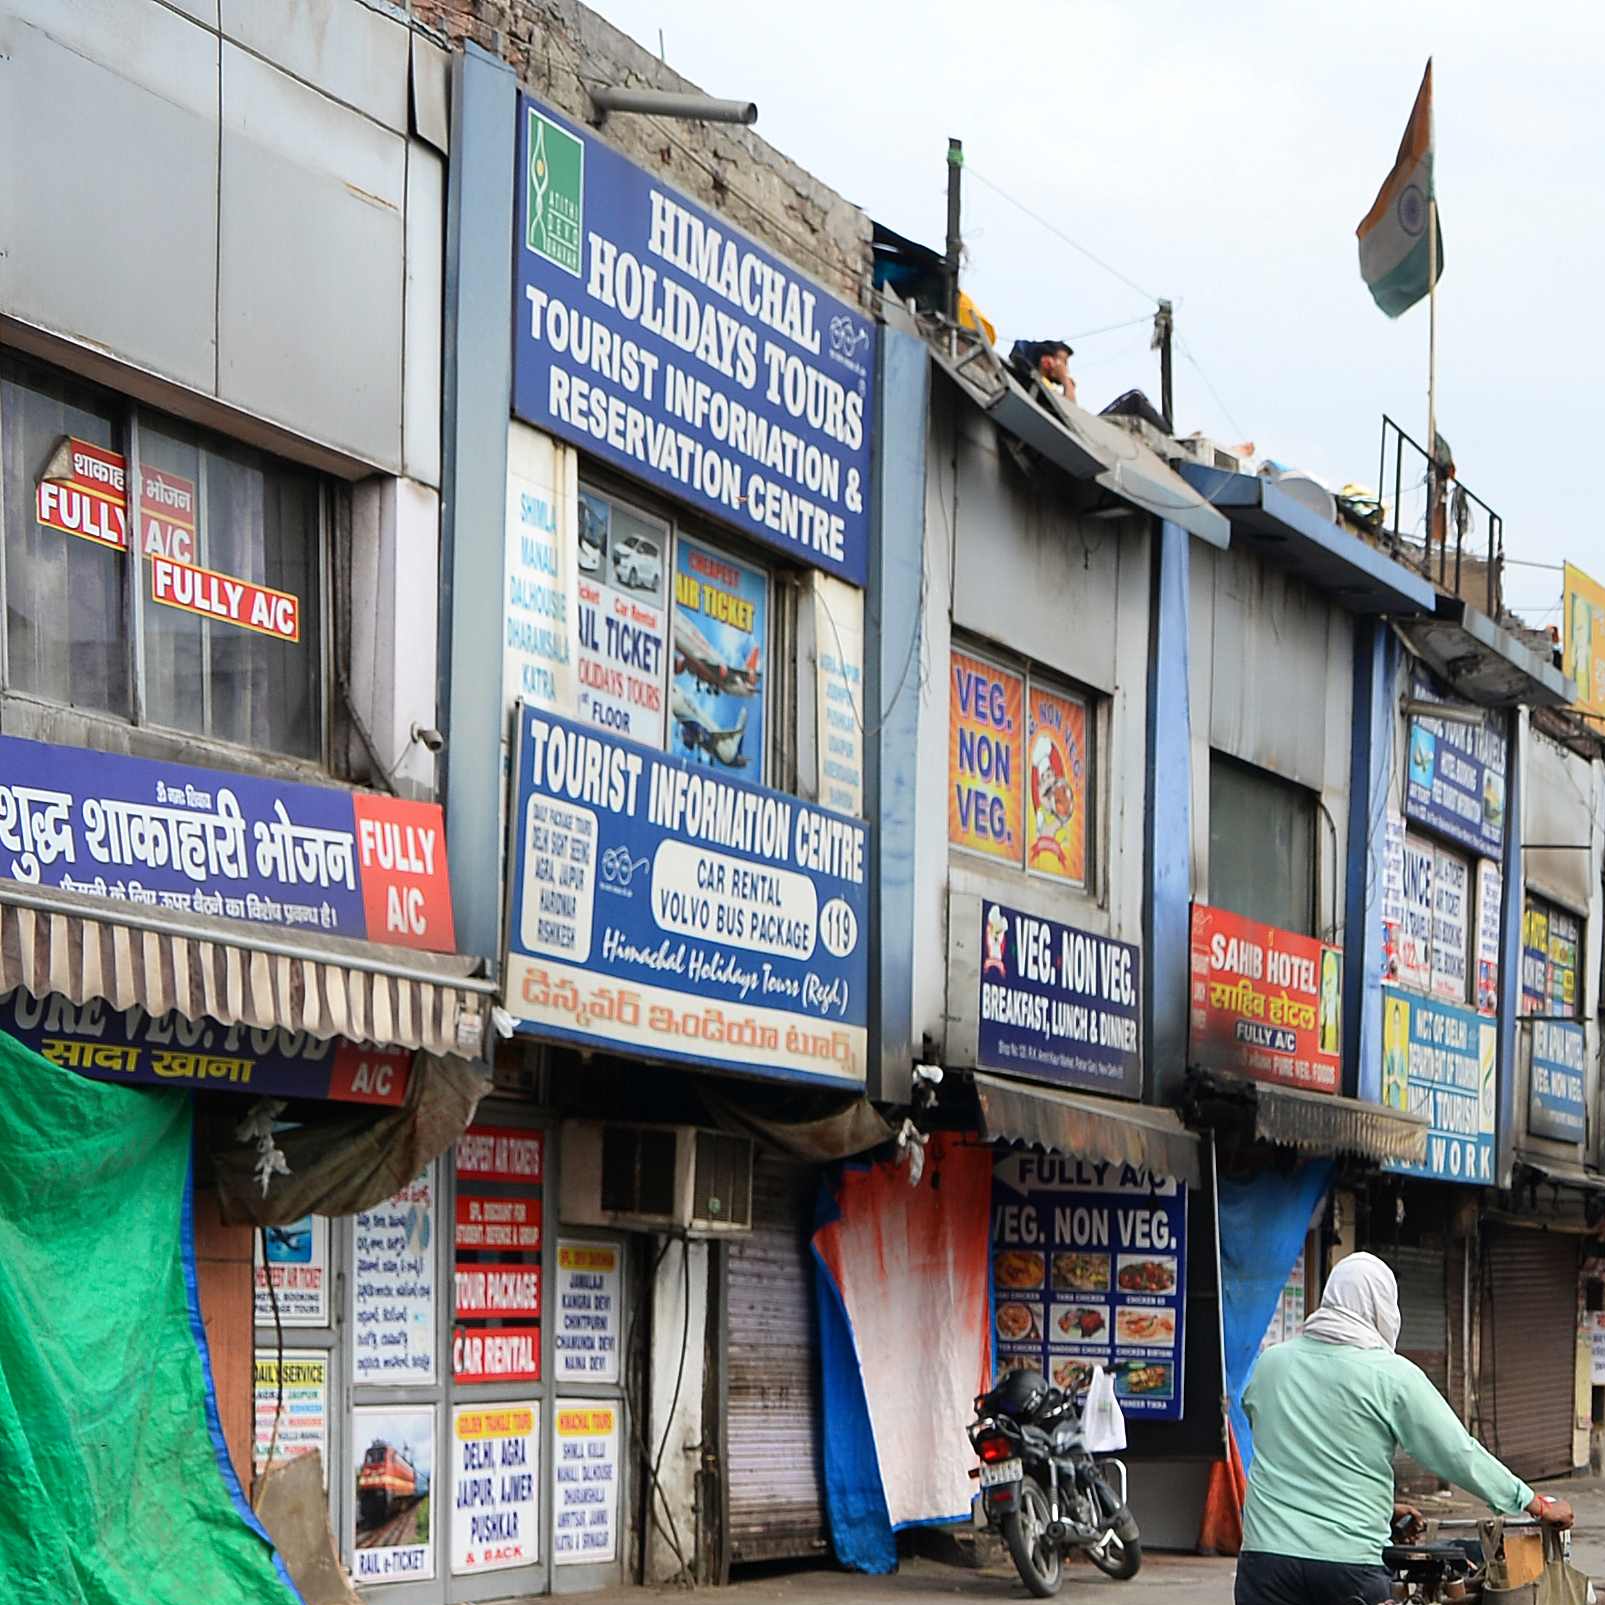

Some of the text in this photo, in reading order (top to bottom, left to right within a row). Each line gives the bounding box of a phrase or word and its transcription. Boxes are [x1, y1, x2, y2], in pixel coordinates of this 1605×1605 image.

[647, 189, 821, 356] HIMACHAL
[586, 232, 864, 451] HOLIDAYS TOURS
[525, 284, 659, 401] TOURIST
[665, 364, 840, 503] INFORMATION
[845, 466, 863, 514] &
[548, 363, 741, 512] RESERVATION
[745, 473, 846, 563] CENTRE
[146, 476, 192, 512] भोजन
[145, 519, 192, 563] A/C
[155, 560, 295, 635] FULLY A/C
[675, 572, 755, 633] AIR TICKET
[605, 616, 663, 676] TICKET
[578, 657, 624, 698] OLIDAYS
[627, 675, 662, 712] TOURS
[956, 668, 1012, 730] VEG.
[592, 700, 631, 734] FLOOR
[959, 727, 1010, 784] NON
[531, 720, 864, 884] TOURIST INFORMATION CENTRE
[956, 783, 1012, 843] VEG.
[0, 784, 355, 891] शुद्ध शाकाहारी भोजन
[360, 818, 436, 875] FULLY
[160, 889, 191, 914] ऊपर
[226, 895, 246, 918] का
[698, 859, 782, 908] CAR RENTAL
[386, 886, 427, 936] A/C
[660, 888, 710, 930] VOLVO
[717, 903, 744, 937] BUS
[750, 910, 809, 951] PACKAGE
[828, 904, 851, 950] 119
[603, 927, 685, 974] Himachal
[689, 955, 759, 998] Holidays
[762, 963, 800, 998] Tours
[1016, 916, 1055, 985] VEG.
[1062, 931, 1097, 996] NON
[1100, 942, 1136, 1007] VEG.
[1211, 933, 1317, 994] SAHIB HOTEL
[13, 987, 105, 1037] URE
[123, 1003, 213, 1047] VEG.
[982, 983, 1136, 1053] BREAKFAST, LUNCH & DINNER
[1269, 990, 1316, 1030] होटल
[41, 1039, 256, 1084] सादा खाना
[1237, 1023, 1296, 1051] FULLY A/C
[351, 1064, 394, 1095] A/C
[1018, 1157, 1109, 1186] FULLY
[1055, 1207, 1109, 1246] NON
[1117, 1208, 1177, 1249] VEG.
[455, 1271, 538, 1310] TOUR PACKAGE
[284, 1364, 323, 1383] SERVICE
[453, 1336, 535, 1374] CAR RENTAL
[501, 1438, 527, 1468] AGRA
[501, 1474, 533, 1504] AJMER
[471, 1512, 519, 1545] PUSHKAR
[359, 1553, 381, 1575] RAIL
[484, 1546, 522, 1562] BACK
